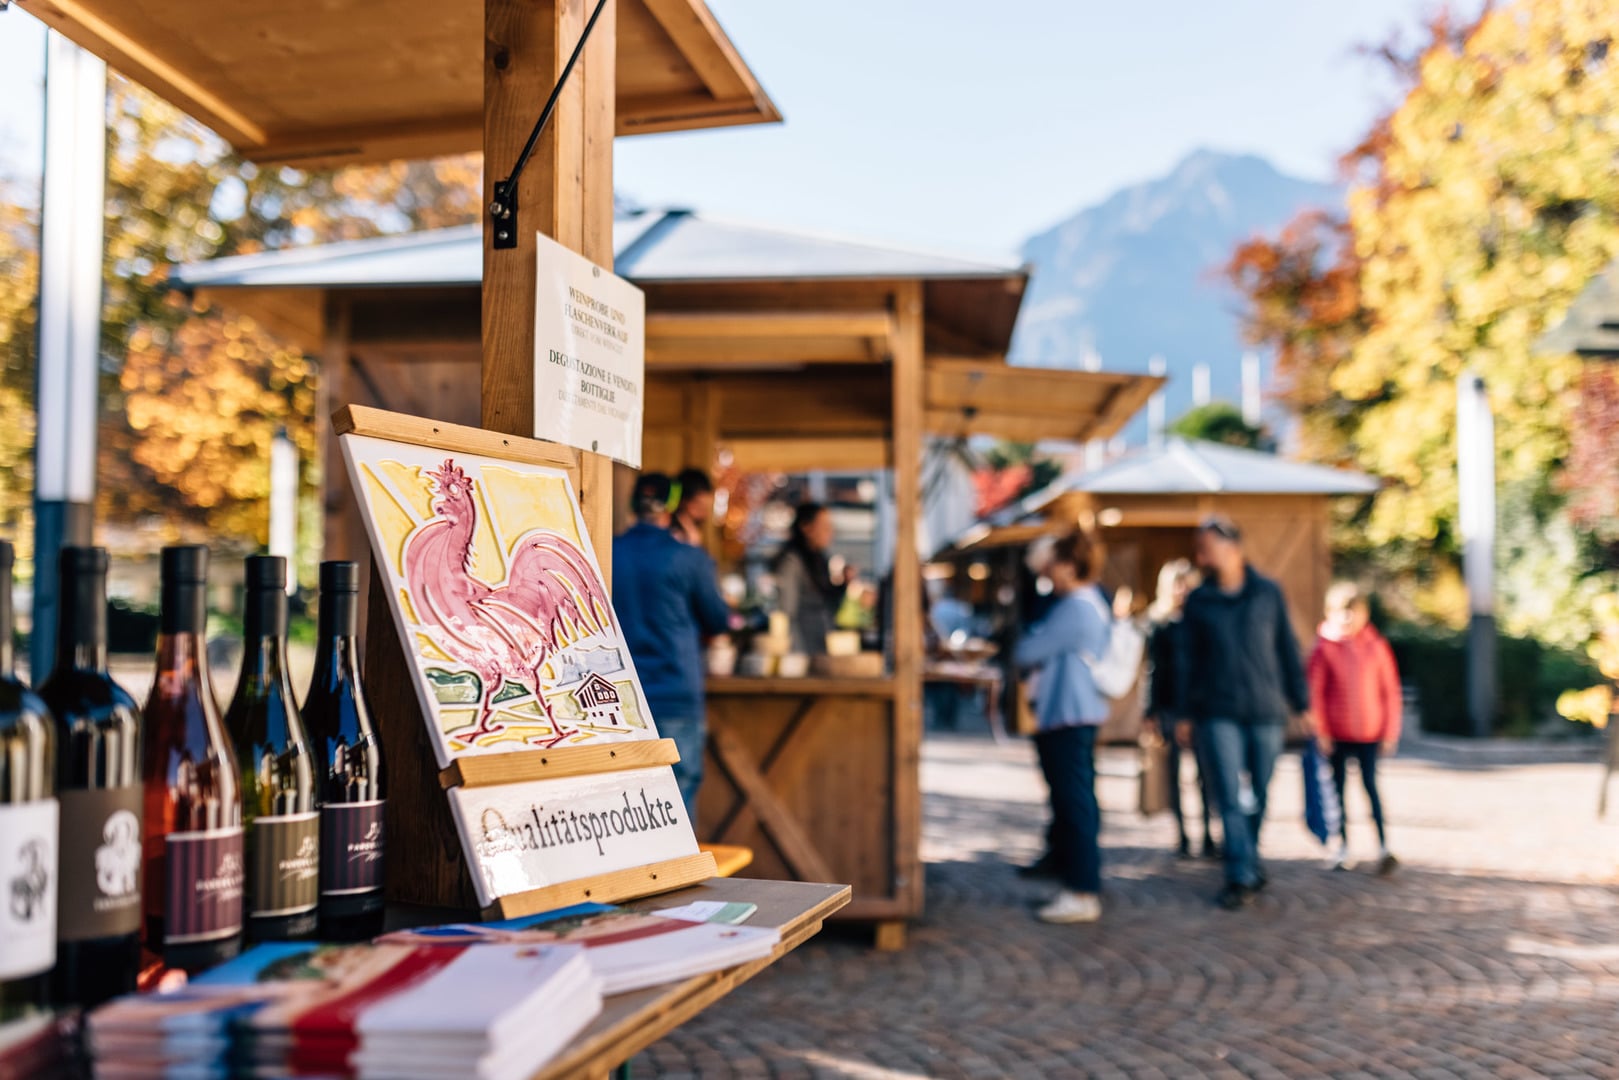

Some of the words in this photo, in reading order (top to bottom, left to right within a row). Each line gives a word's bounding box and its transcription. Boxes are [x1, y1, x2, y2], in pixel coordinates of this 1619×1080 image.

[568, 286, 609, 318] WEINPROBE
[610, 307, 626, 325] UND
[548, 348, 606, 382] DEGUSTAZIONE
[607, 371, 612, 384] E
[613, 374, 638, 396] VENDITA
[580, 379, 616, 403] BOTTIGLIE
